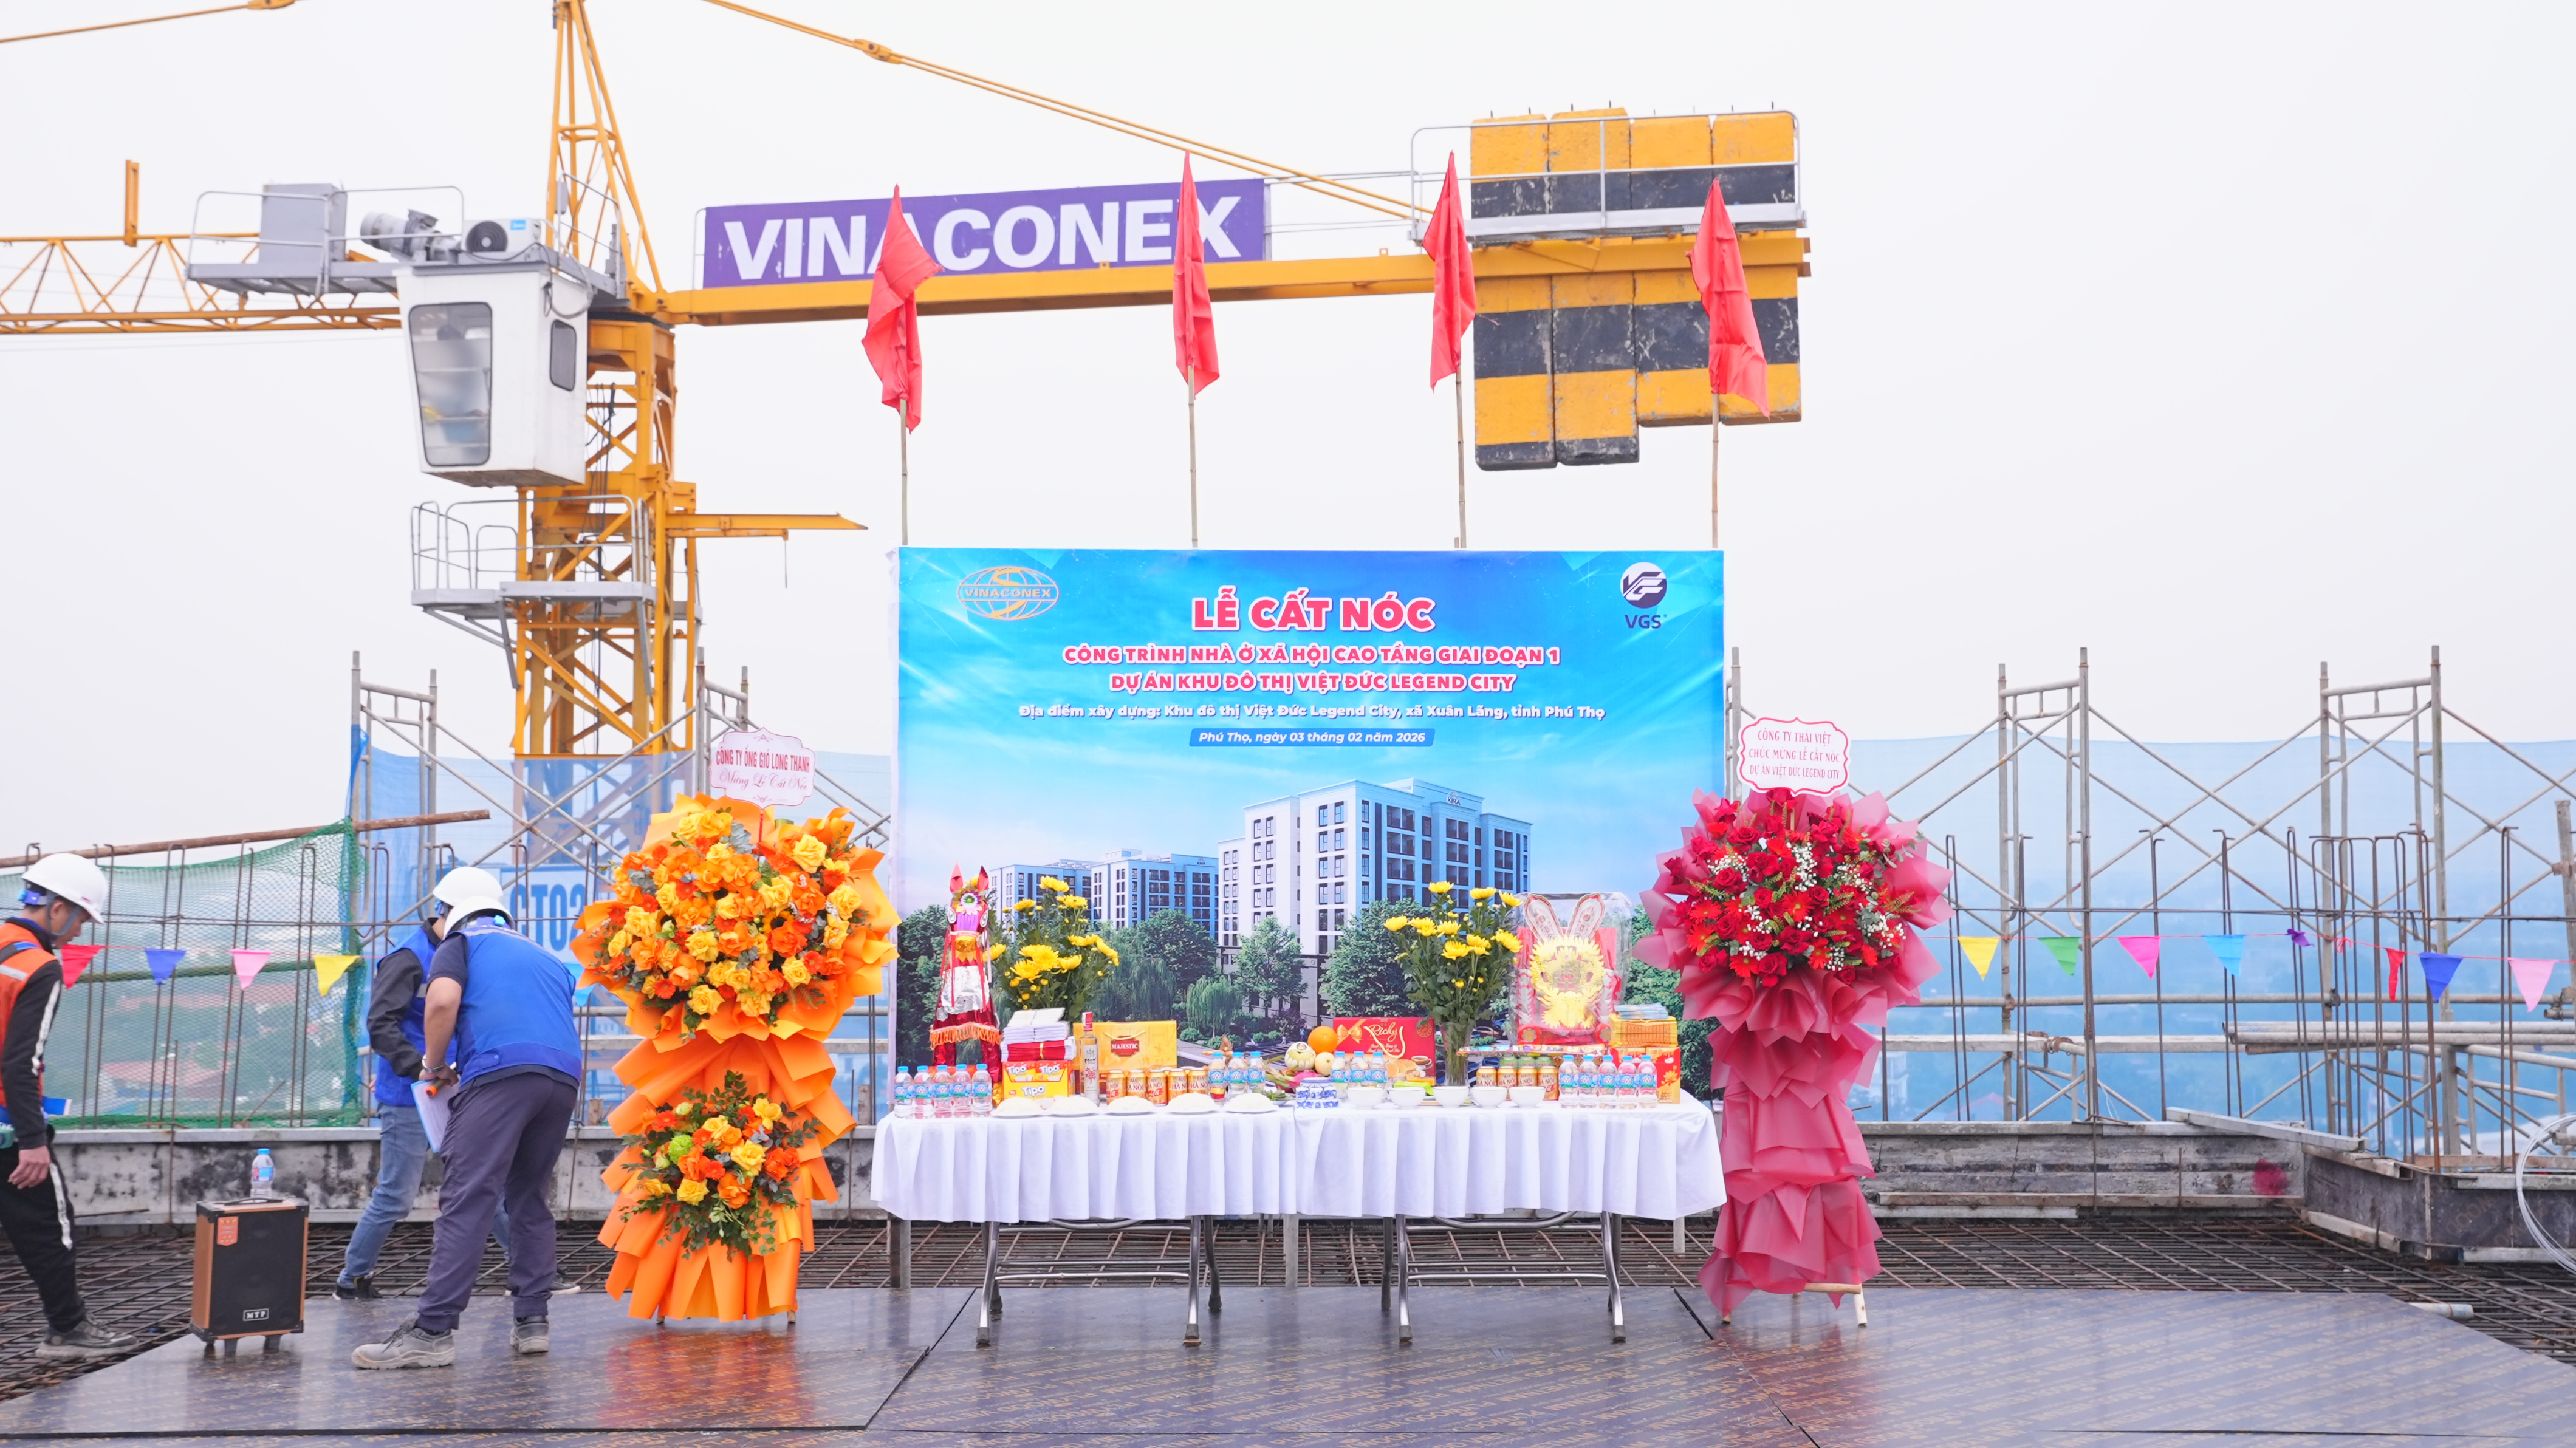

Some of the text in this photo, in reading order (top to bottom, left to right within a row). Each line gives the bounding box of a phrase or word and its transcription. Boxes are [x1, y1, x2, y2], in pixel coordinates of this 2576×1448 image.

[964, 587, 1052, 598] VINACONEX
[1194, 587, 1434, 630] LỄ CẤT NÓC
[1625, 615, 1662, 629] VGS
[1064, 643, 1560, 666] CÔNG TRÌNH NHÀ Ở XÃ HỘI CAO TẦNG GIAI ĐOẠN 1
[1112, 671, 1516, 694] DỰ ÁN KHU ĐÔ THỊ VIỆT ĐỨC LEGEND CITY
[1019, 703, 1606, 721] Địa điểm xây dựng: Khu đô thị Việt Đức Legend City, xã Xuân Lãng, tỉnh Phú Thọ
[1199, 731, 1426, 745] Phú Thọ, ngày 03 tháng 02 năm 2026
[1758, 728, 1832, 747] CÔNG TY THÁI VIỆT
[716, 746, 733, 765] CÔNG
[735, 750, 743, 766] TY
[759, 749, 770, 768] GIÓ
[772, 753, 788, 771] LONG
[1749, 746, 1840, 763] CHÚC MỪNG LỄ CẤT NÓC
[720, 768, 750, 790] Mừng
[752, 773, 767, 788] Lễ
[1750, 763, 1840, 780] DỰ ÁN VIỆT ĐỨC LEGEND CITY
[1368, 1022, 1399, 1042] Richy
[1006, 1065, 1027, 1075] Tipo
[1039, 1065, 1060, 1075] Tipo
[1021, 1086, 1045, 1097] Tipo
[246, 1310, 267, 1320] MTP
